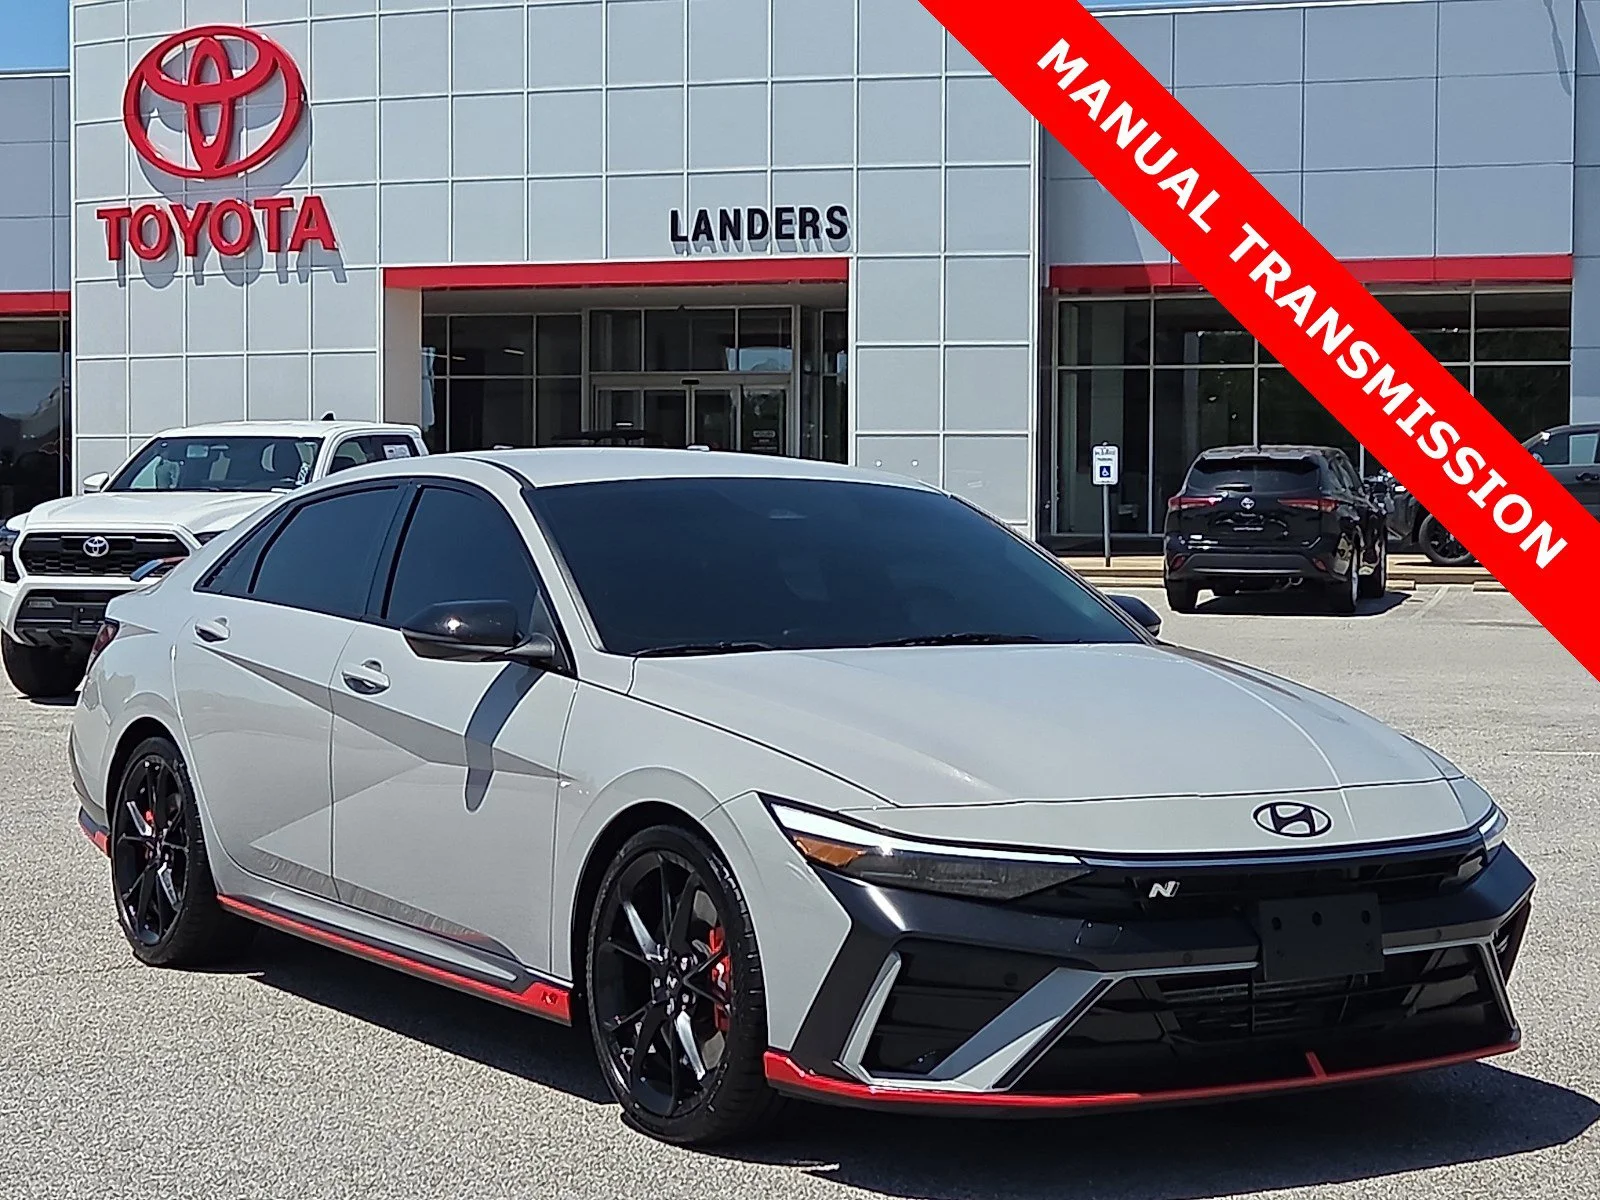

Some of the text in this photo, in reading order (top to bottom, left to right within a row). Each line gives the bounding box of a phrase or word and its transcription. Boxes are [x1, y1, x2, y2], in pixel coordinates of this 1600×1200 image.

[97, 196, 338, 261] TOYOTA
[670, 205, 849, 242] LANDERS
[1148, 880, 1180, 899] N
